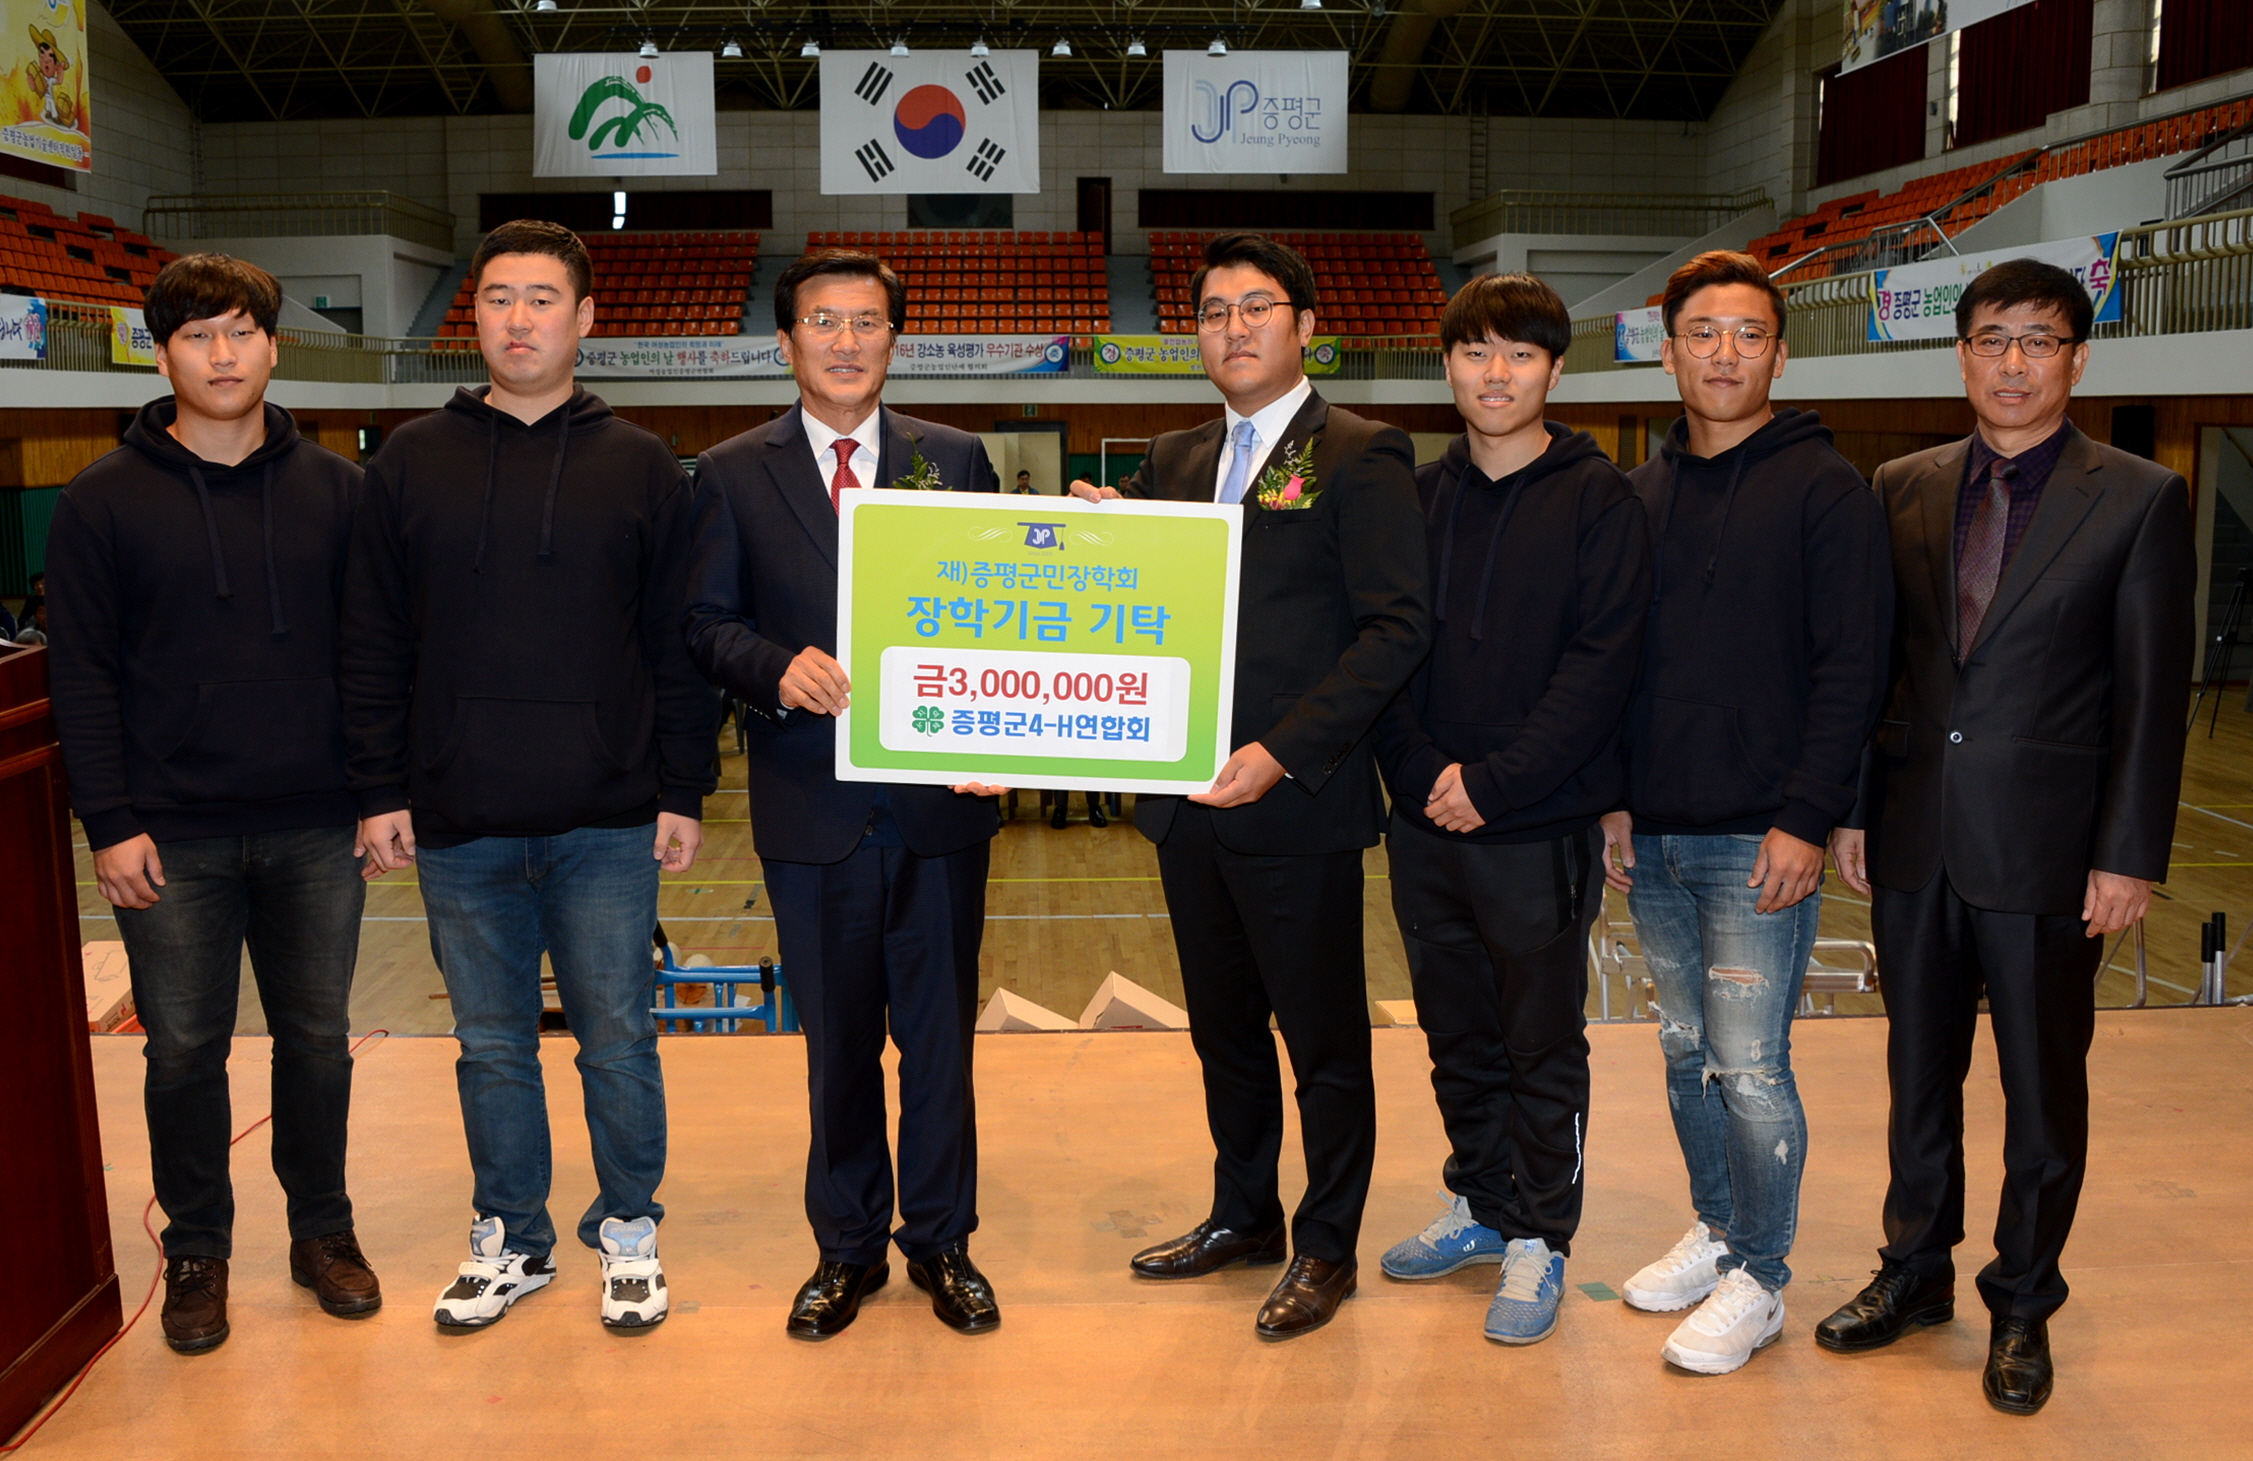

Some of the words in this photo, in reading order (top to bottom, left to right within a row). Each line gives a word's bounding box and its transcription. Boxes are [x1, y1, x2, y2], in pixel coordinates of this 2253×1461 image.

[1262, 97, 1321, 130] 증평군
[1240, 133, 1274, 147] Jeung
[1278, 133, 1321, 147] Pyeong
[1878, 289, 1892, 321] 경
[1893, 289, 1921, 320] 증평군
[2089, 258, 2110, 296] 축
[131, 327, 153, 350] 증평군
[917, 343, 945, 359] 강소농
[947, 343, 984, 359] 육성평가
[986, 343, 1023, 358] 우수기관
[1025, 343, 1044, 358] 수상
[1104, 347, 1117, 361] 경
[1124, 347, 1155, 362] 증평군
[1158, 347, 1201, 362] 농업인의
[586, 351, 617, 367] 증평군
[620, 351, 660, 366] 농업인의
[664, 351, 674, 366] 날
[677, 350, 707, 366] 행사를
[710, 349, 772, 365] 축하드립니다
[936, 560, 1138, 592] 재)증평군민장학회
[906, 596, 1072, 642] 장학기금
[1089, 603, 1171, 646] 기탁
[913, 664, 1148, 706] 금3,000,000원
[951, 709, 1150, 742] 증평군4-H연합회
